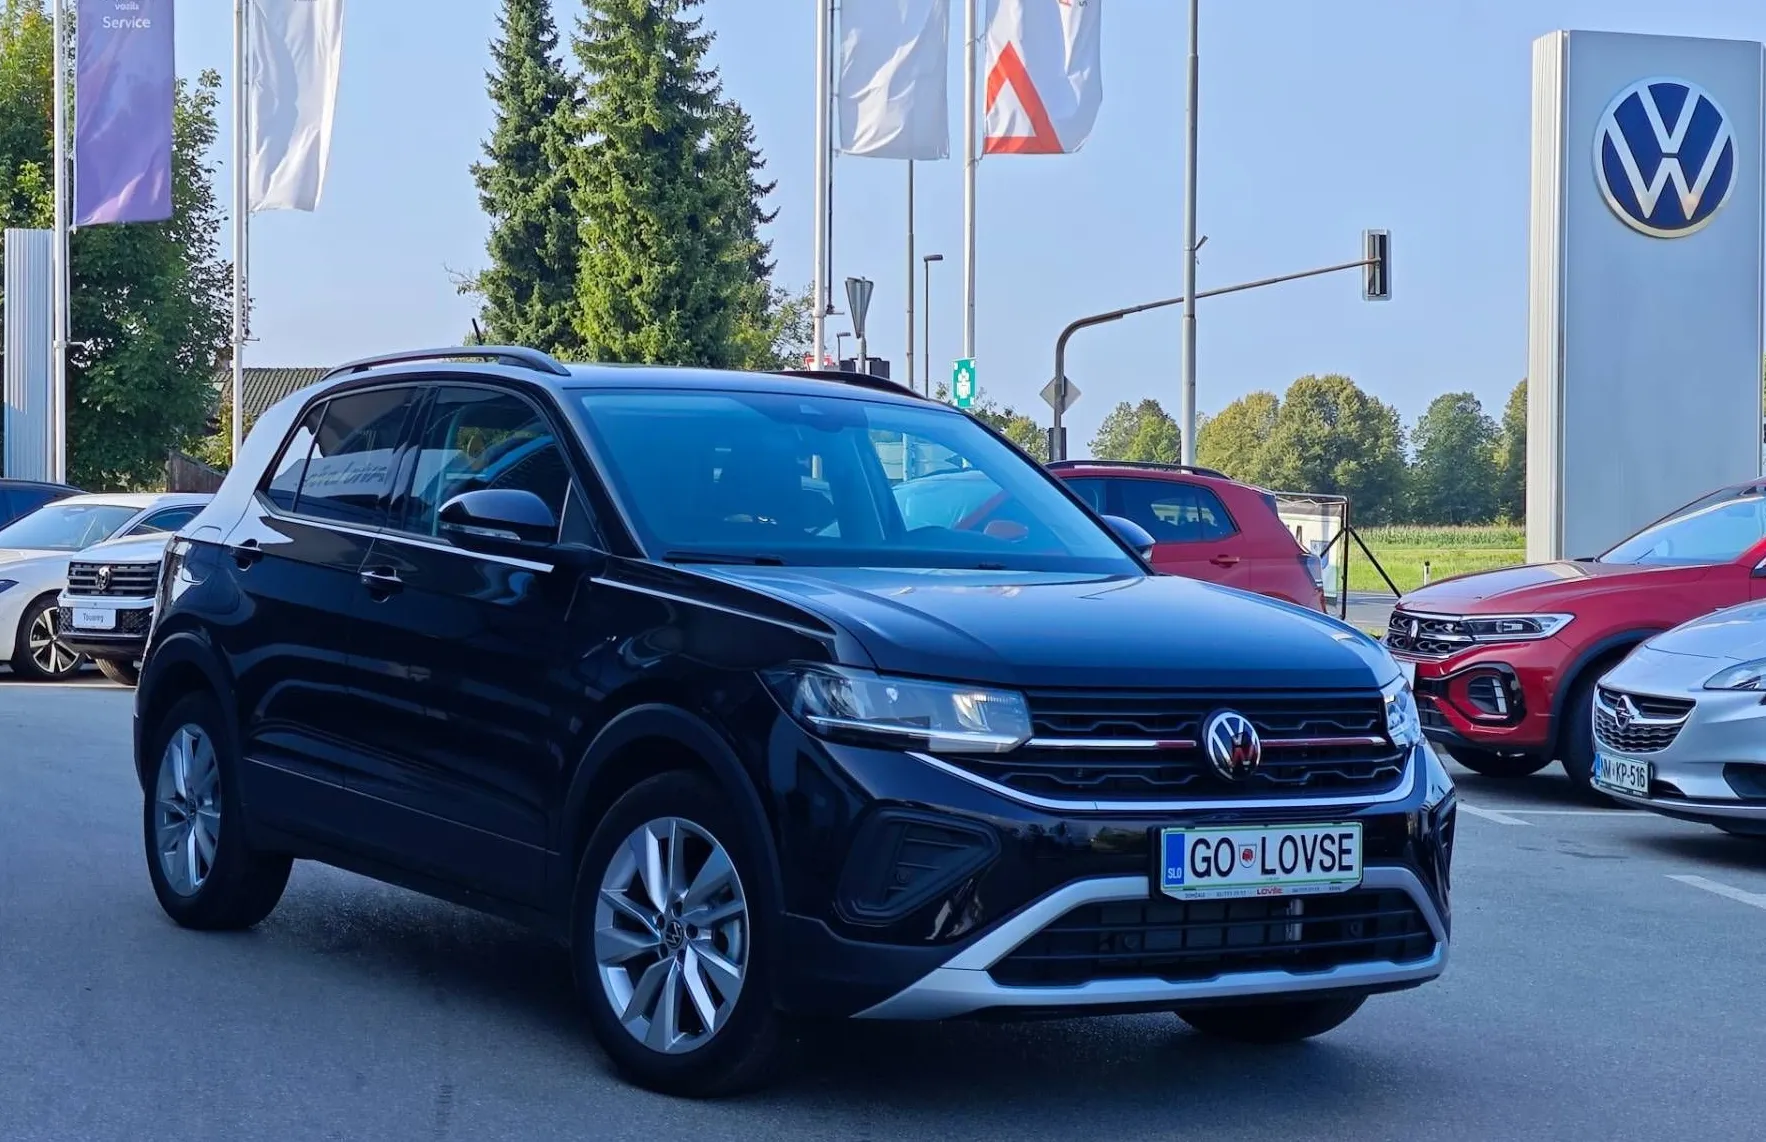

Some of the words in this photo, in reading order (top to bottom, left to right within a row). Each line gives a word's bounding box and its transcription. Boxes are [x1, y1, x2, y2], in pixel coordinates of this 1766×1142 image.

[102, 16, 151, 29] Service
[1615, 762, 1645, 788] KP-516
[1191, 837, 1235, 879] GO
[1260, 833, 1354, 875] LOVSE
[1167, 867, 1182, 880] SLO
